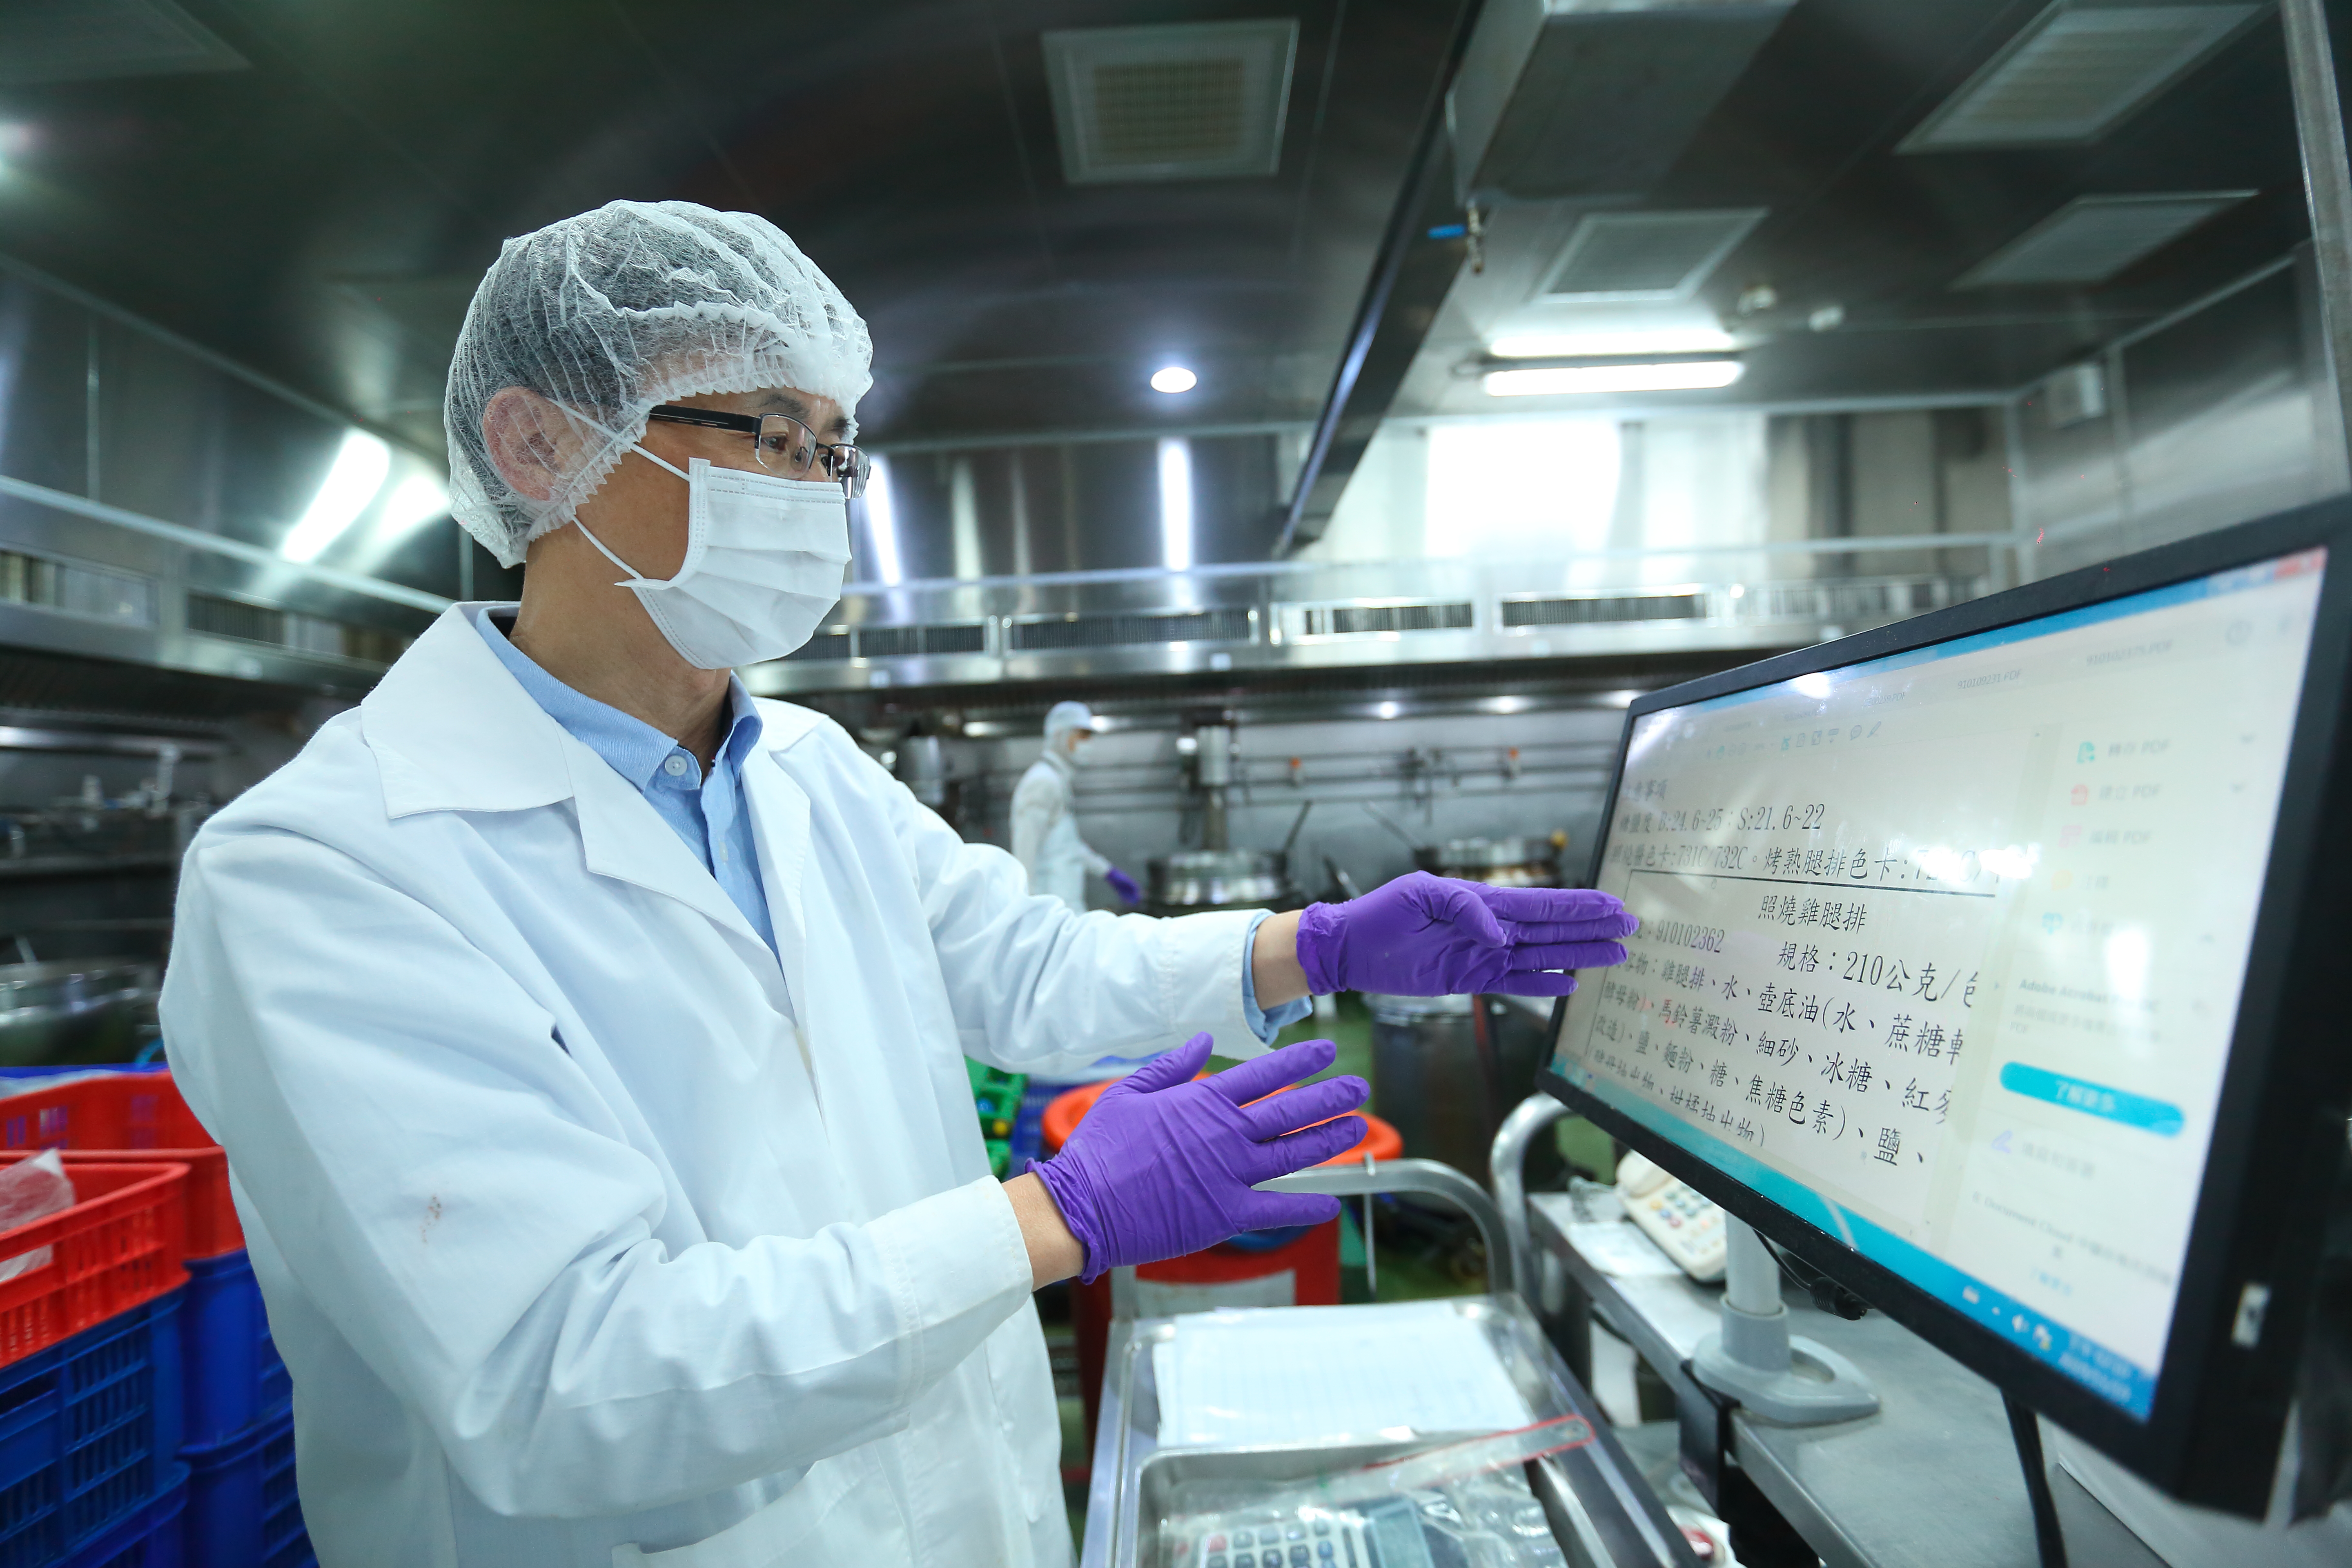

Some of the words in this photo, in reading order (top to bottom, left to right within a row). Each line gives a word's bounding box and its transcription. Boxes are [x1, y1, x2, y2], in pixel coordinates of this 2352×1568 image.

[1757, 894, 1869, 935] 照燒雞腿排
